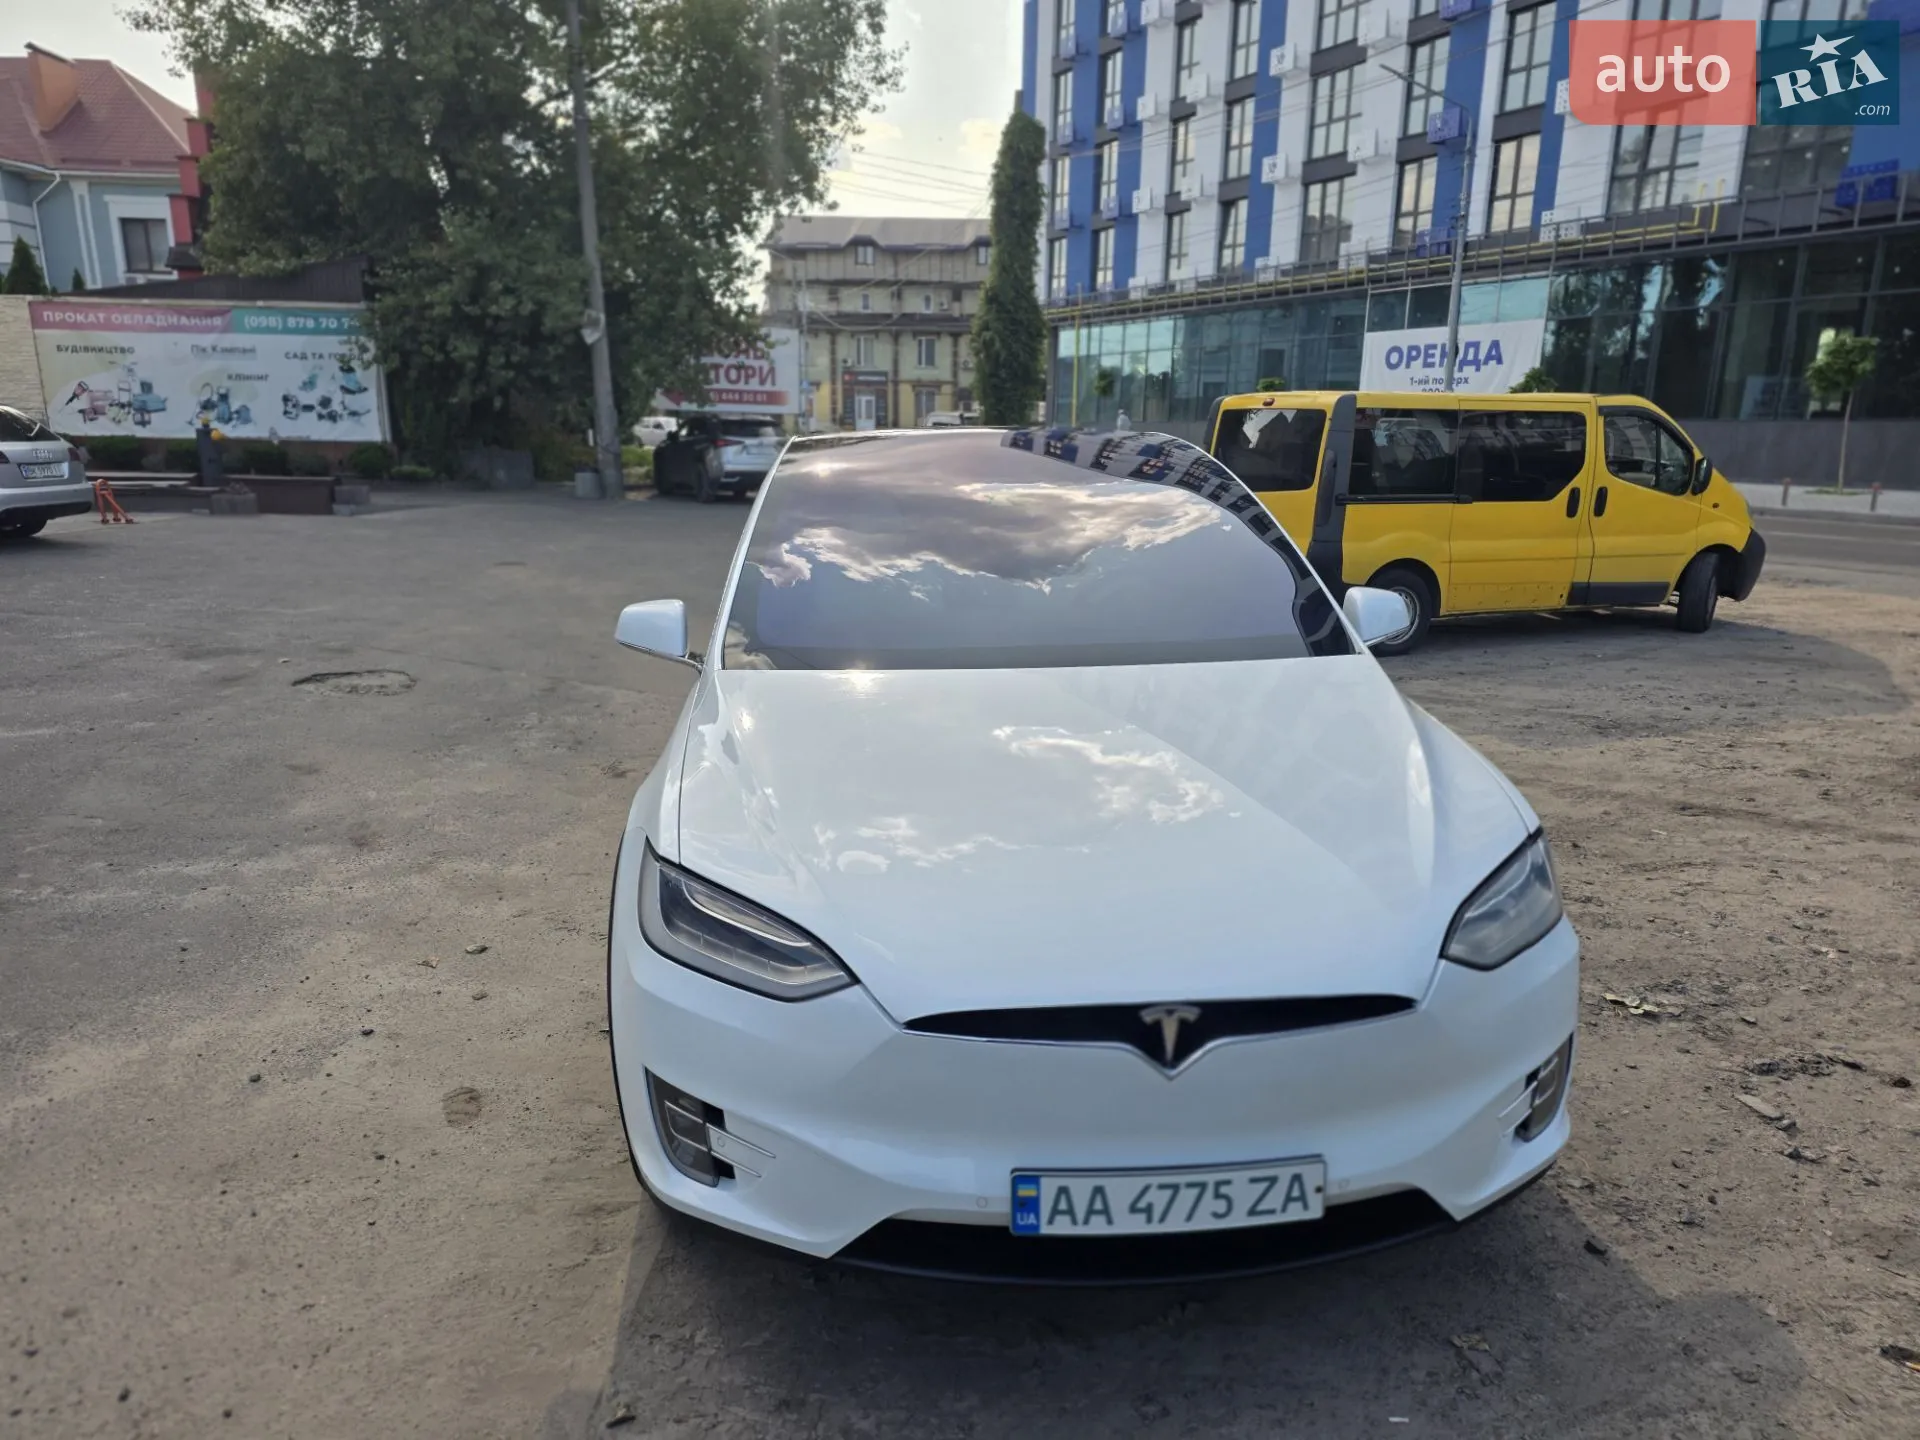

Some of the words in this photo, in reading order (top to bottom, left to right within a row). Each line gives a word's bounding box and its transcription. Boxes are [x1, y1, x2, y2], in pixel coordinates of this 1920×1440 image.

[43, 311, 105, 324] ПРОКАТ
[111, 313, 222, 327] ОБЛАДНАННЯ
[319, 317, 338, 329] 70
[56, 344, 136, 355] БУДІВНИЦТВО
[284, 351, 308, 361] САД
[312, 352, 324, 361] ТА
[1432, 376, 1470, 387] поерх
[1047, 1184, 1114, 1227] AA
[1128, 1179, 1234, 1225] 4775
[1246, 1172, 1310, 1218] ZA
[1016, 1213, 1038, 1226] UA
